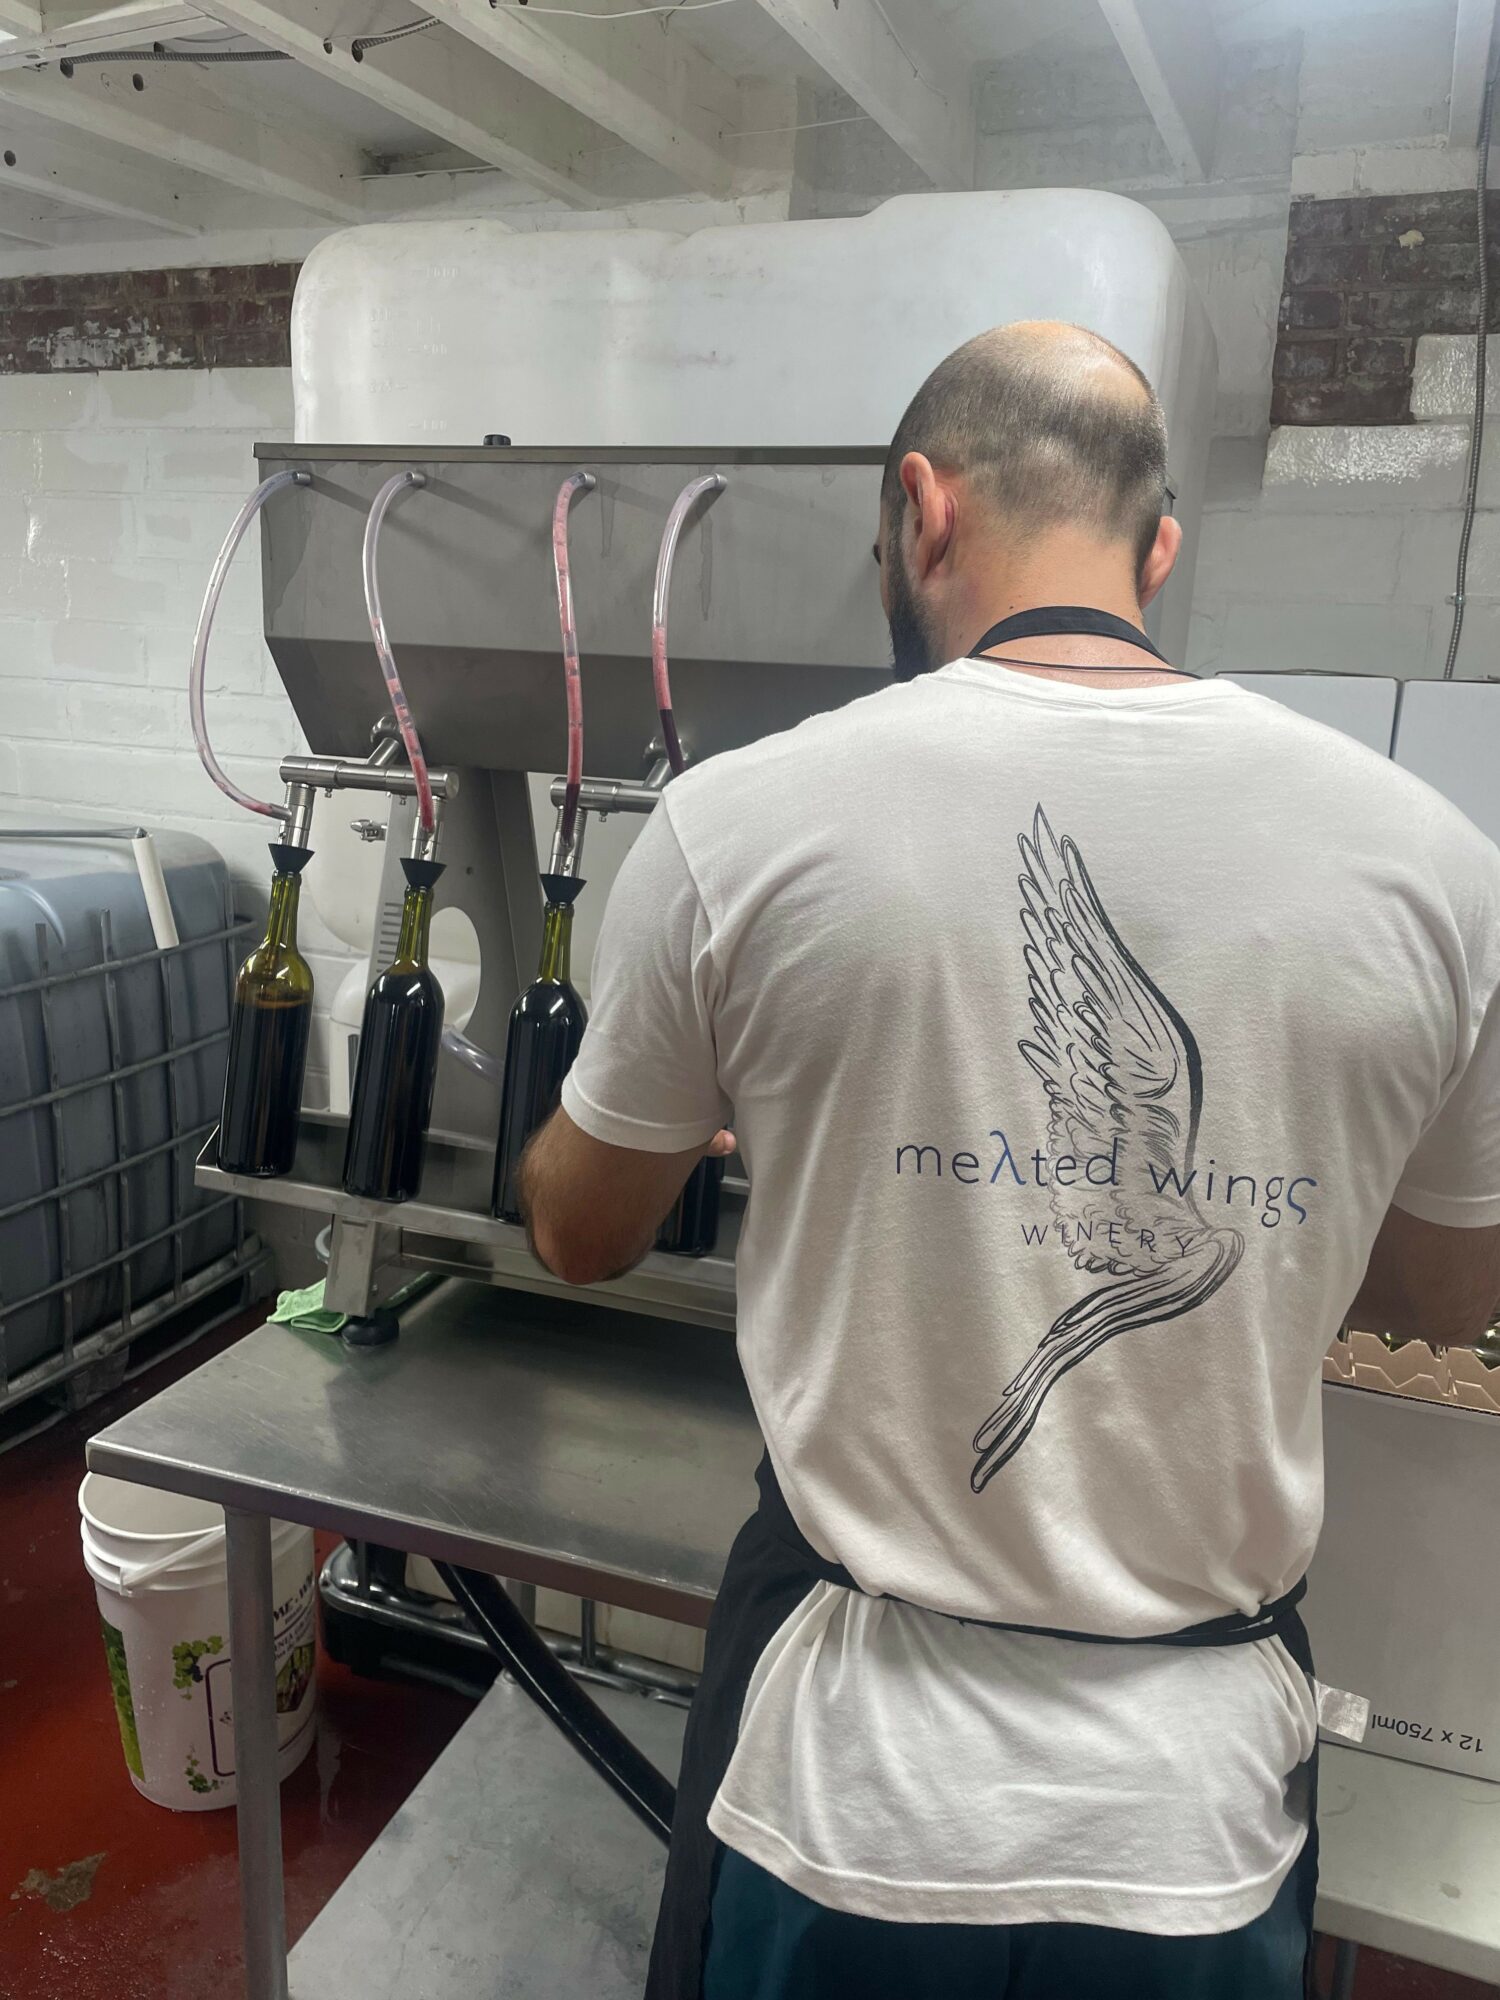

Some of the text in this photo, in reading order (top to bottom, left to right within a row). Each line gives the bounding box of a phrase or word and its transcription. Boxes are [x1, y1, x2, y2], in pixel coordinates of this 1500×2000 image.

[1020, 1221, 1194, 1258] WINERY
[1371, 1714, 1483, 1753] 12 x 750ml
